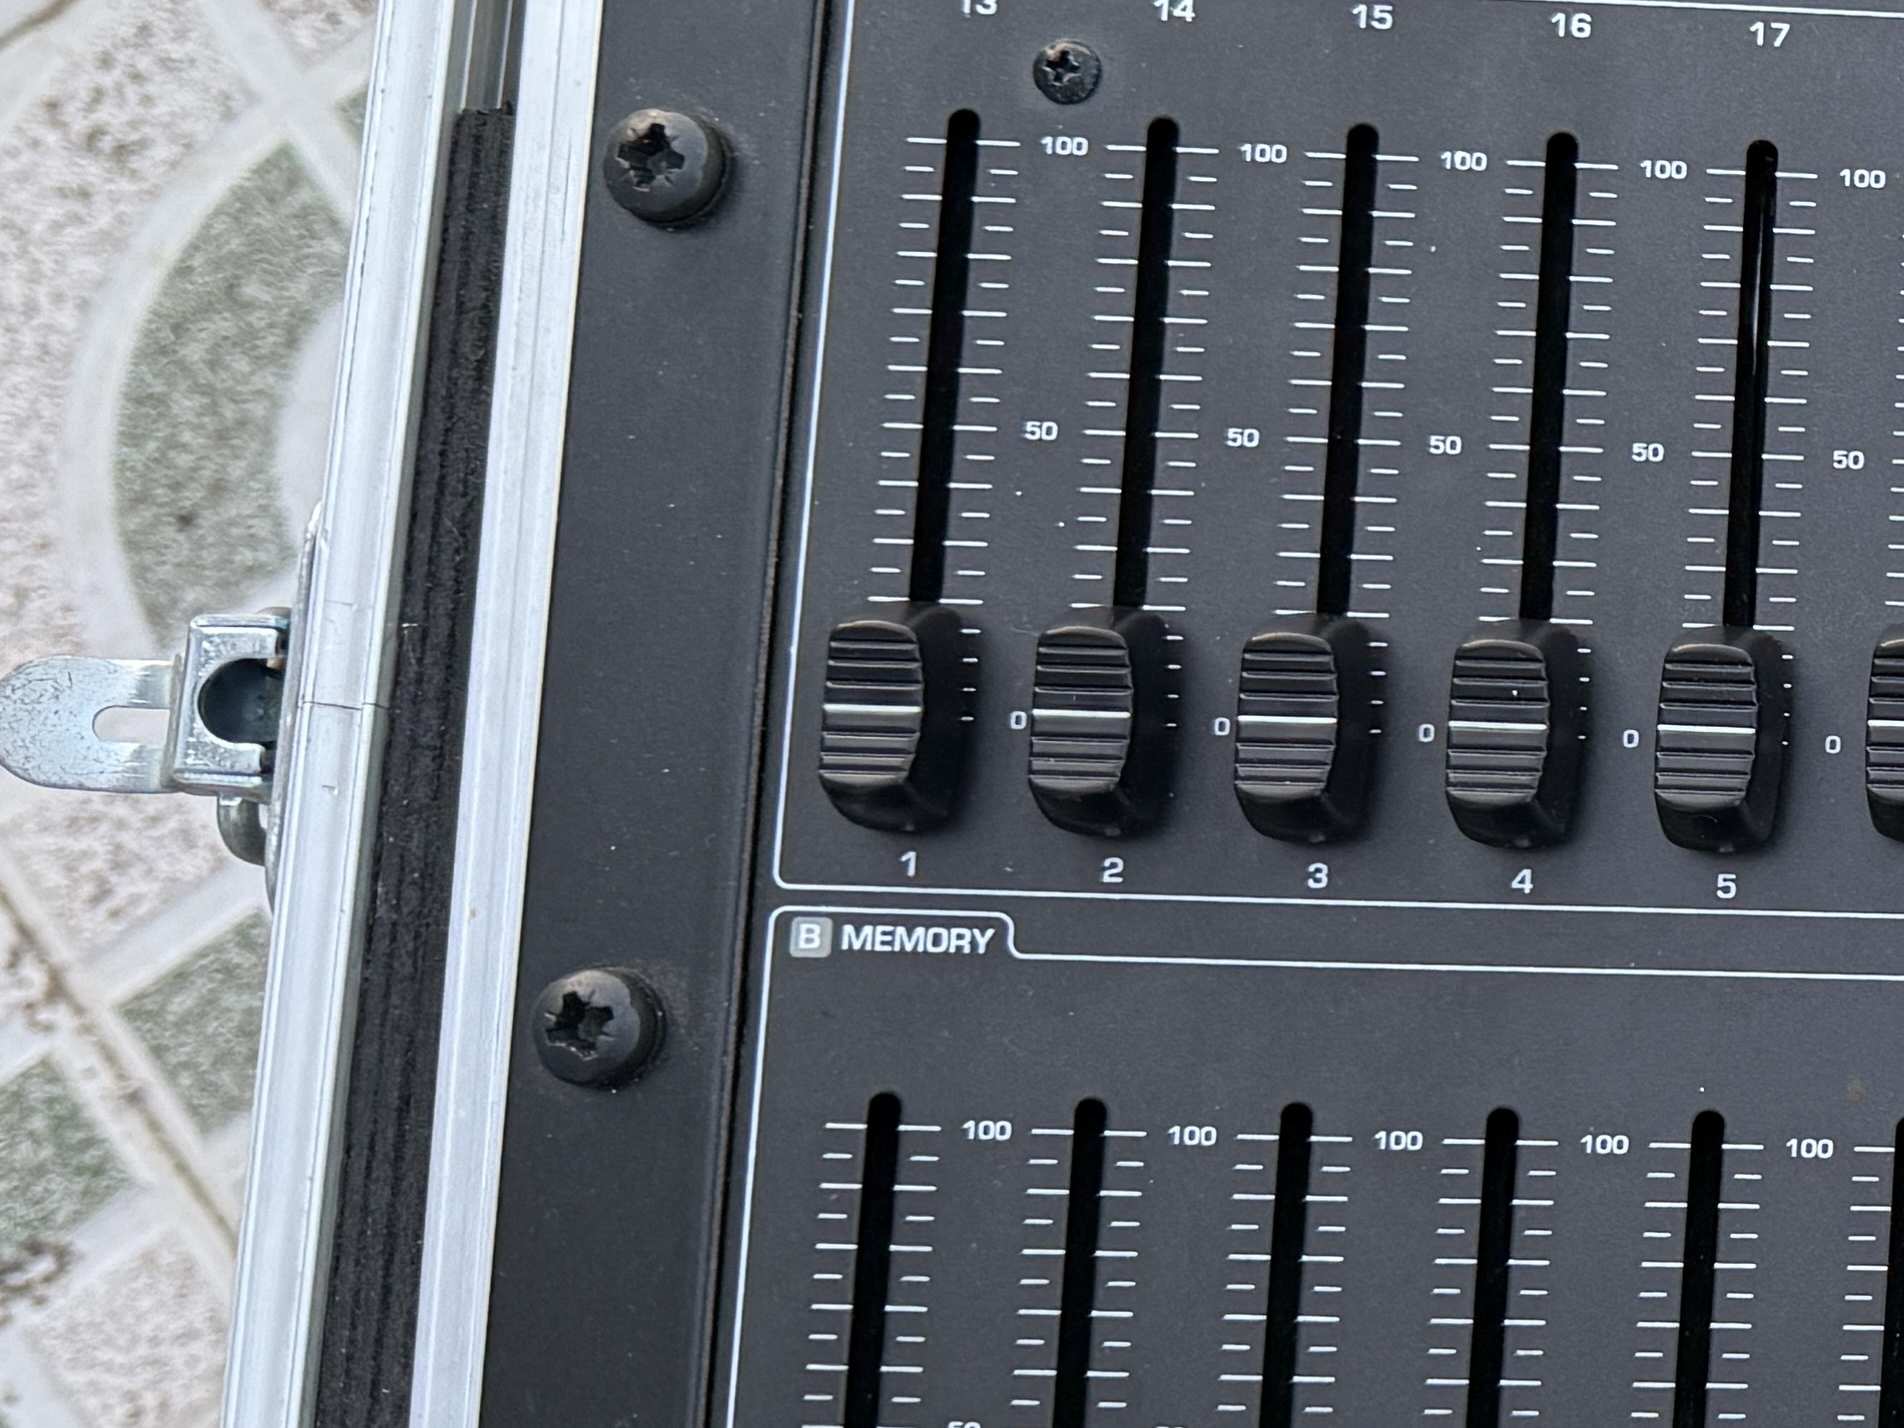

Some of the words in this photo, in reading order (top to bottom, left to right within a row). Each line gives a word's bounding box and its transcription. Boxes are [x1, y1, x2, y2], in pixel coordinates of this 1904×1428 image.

[1352, 4, 1393, 30] 15
[1551, 12, 1592, 38] 16
[1749, 21, 1790, 47] 17
[1041, 136, 1088, 156] 100
[900, 851, 916, 877] 1
[1102, 857, 1124, 883] 2
[1307, 862, 1328, 889] 3
[1511, 868, 1533, 894] 4
[1716, 874, 1737, 899] 5
[799, 923, 820, 948] B
[841, 924, 994, 954] MEMORY
